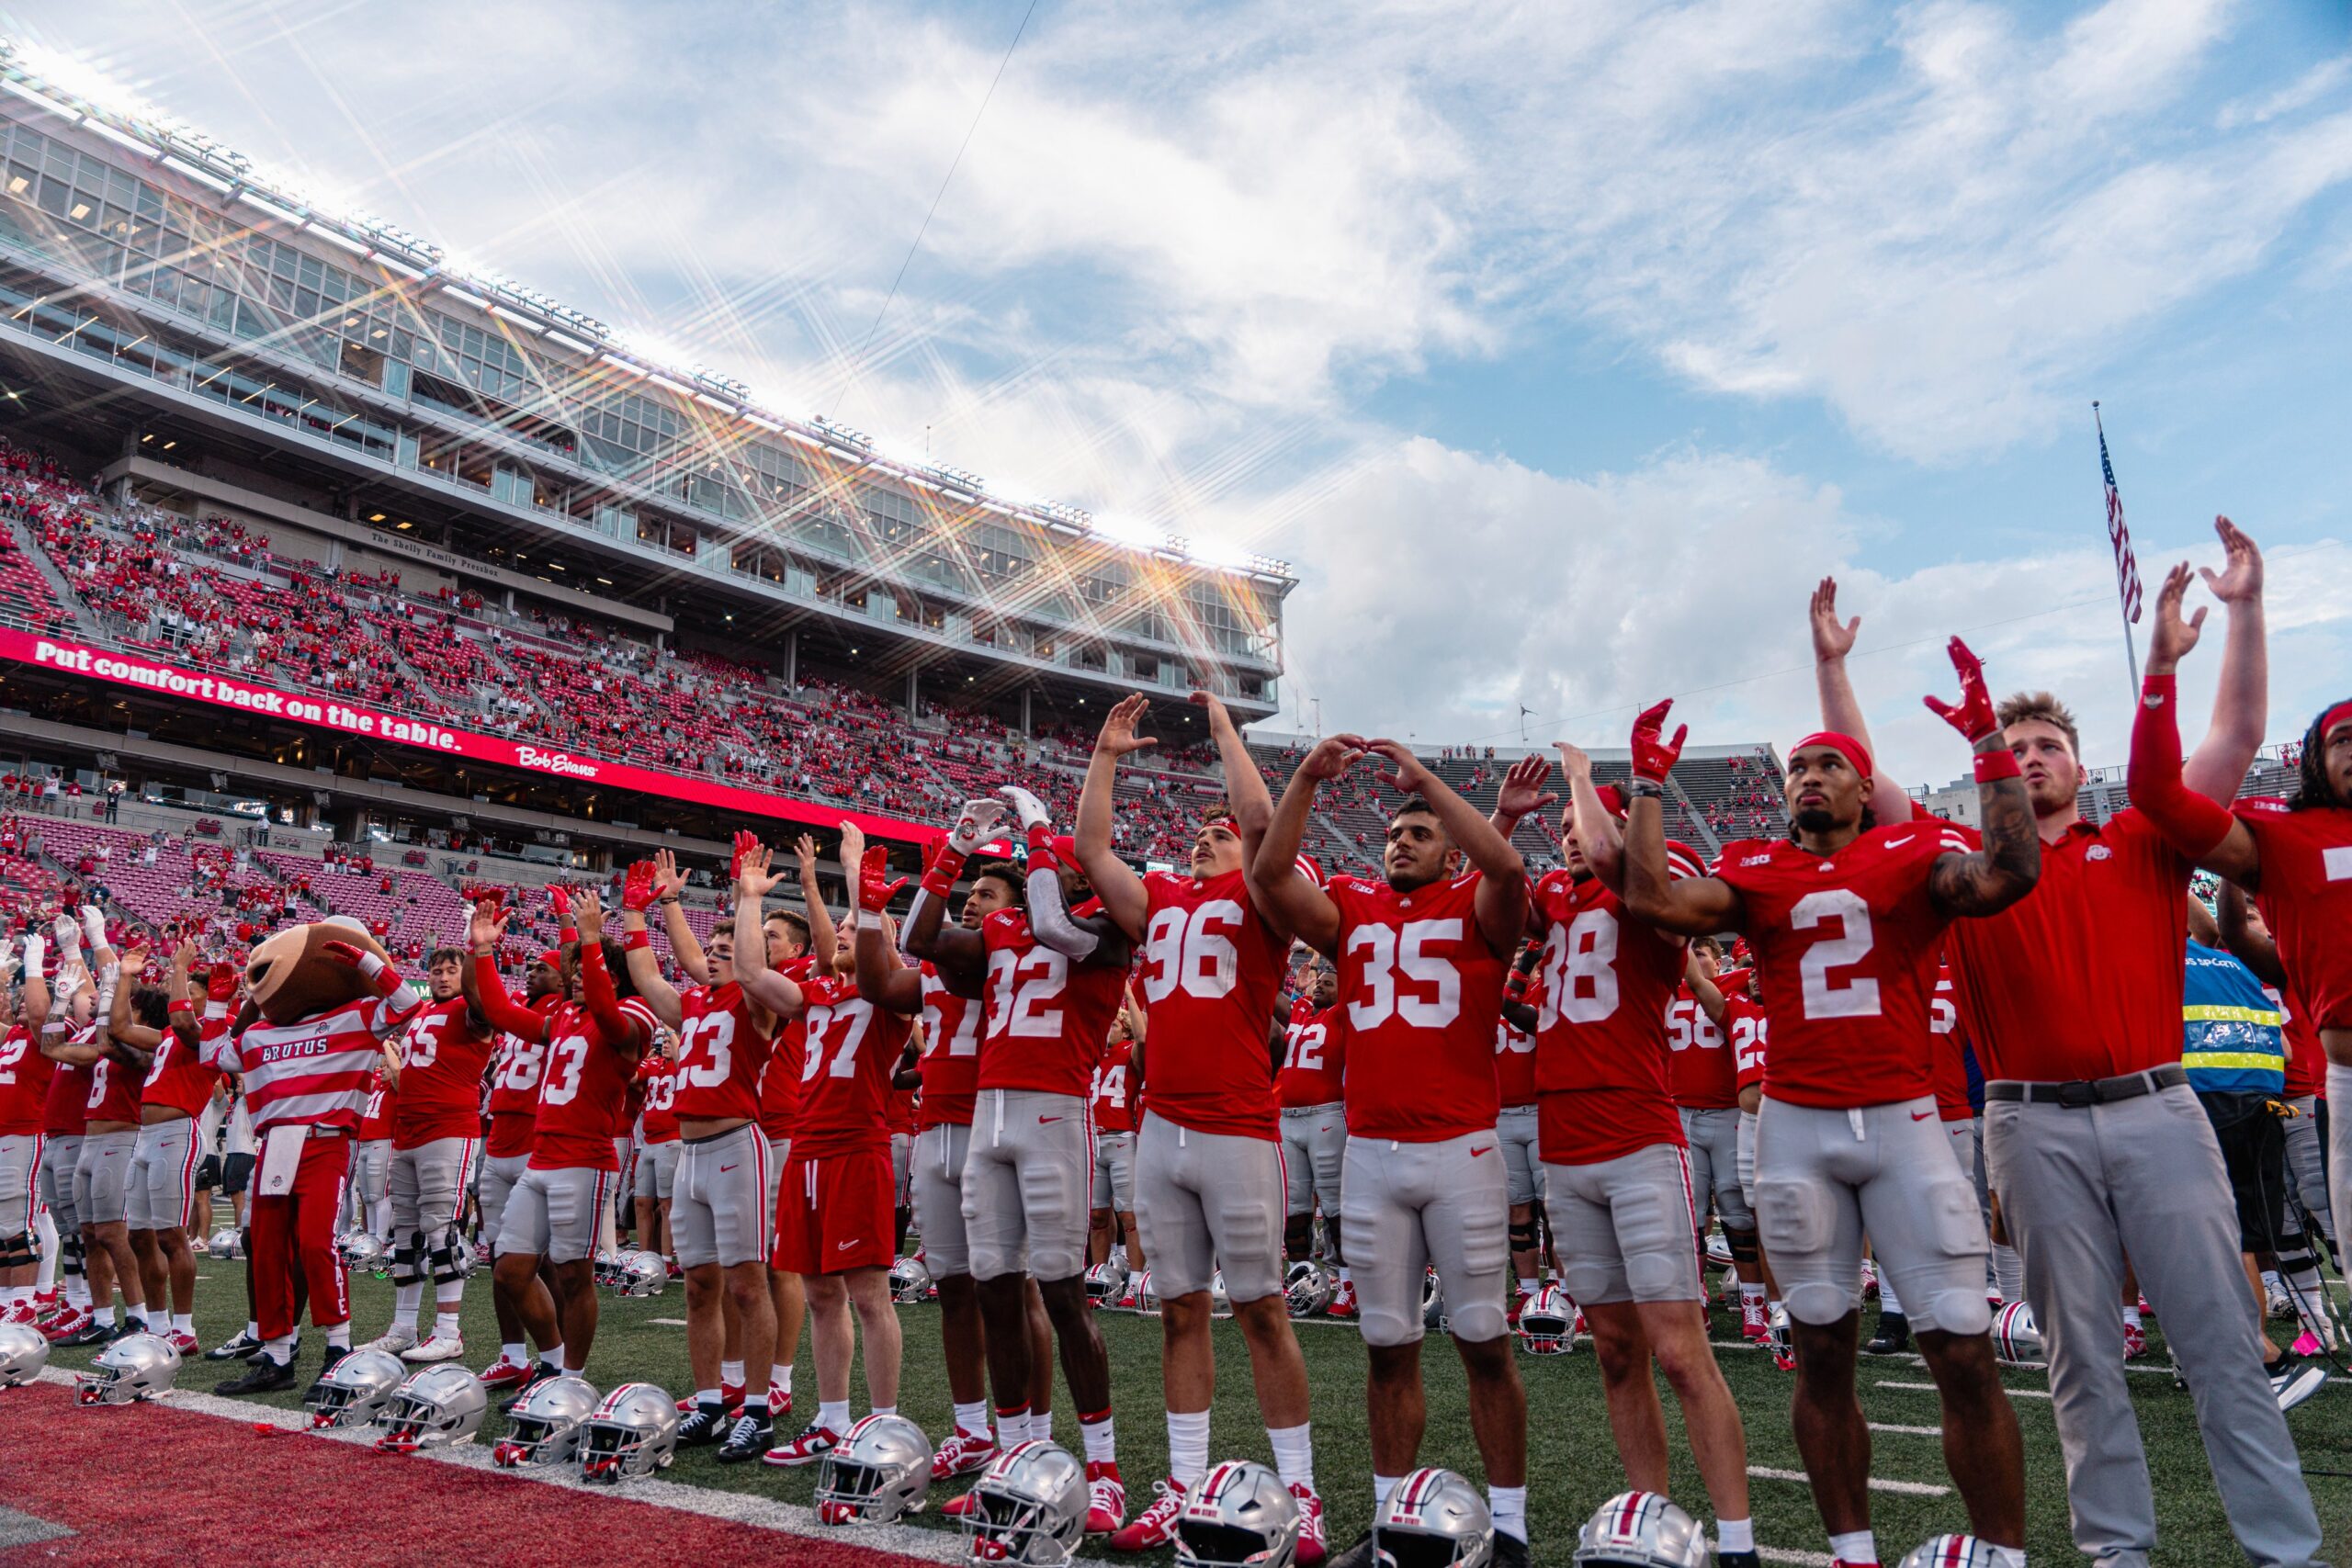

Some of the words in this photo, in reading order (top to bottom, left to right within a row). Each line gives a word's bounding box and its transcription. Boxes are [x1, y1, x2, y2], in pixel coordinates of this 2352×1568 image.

[372, 533, 389, 545] The
[393, 539, 422, 555] Shelly
[426, 548, 457, 567] Family
[461, 559, 499, 577] Pressbox
[35, 641, 92, 671] Put
[94, 658, 214, 698] comfort
[217, 682, 284, 714] back
[286, 700, 322, 722] on
[327, 705, 374, 732] the
[379, 716, 462, 751] table.
[514, 746, 551, 768] Bob
[550, 754, 597, 777] Evans
[985, 945, 1069, 1040] 32
[1144, 899, 1244, 1004] 96
[1347, 919, 1463, 1032] 35
[1790, 888, 1882, 1021] 2
[263, 1037, 328, 1063] BRUTUS
[399, 1014, 448, 1069] 65
[676, 1010, 736, 1090] 23
[801, 998, 874, 1082] 87
[1283, 1022, 1327, 1070] 72
